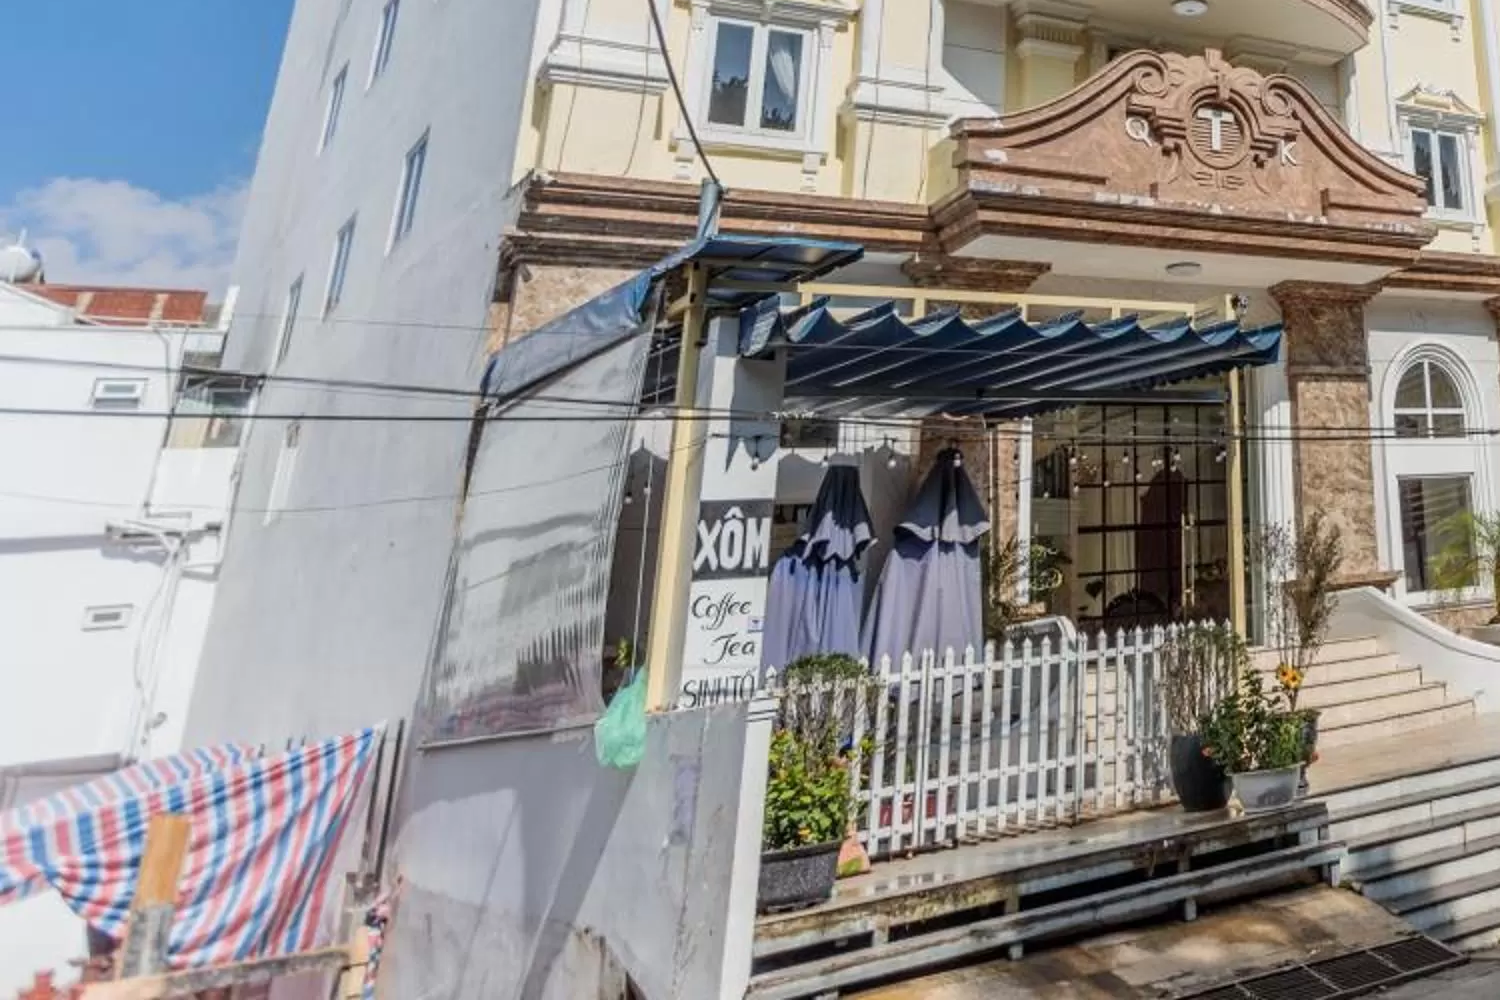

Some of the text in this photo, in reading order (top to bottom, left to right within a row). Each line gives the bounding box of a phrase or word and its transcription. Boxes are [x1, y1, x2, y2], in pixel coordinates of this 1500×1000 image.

[1125, 107, 1297, 166] Q T K
[693, 506, 771, 572] XÔM
[691, 592, 752, 631] Coffee
[703, 632, 756, 665] Tea
